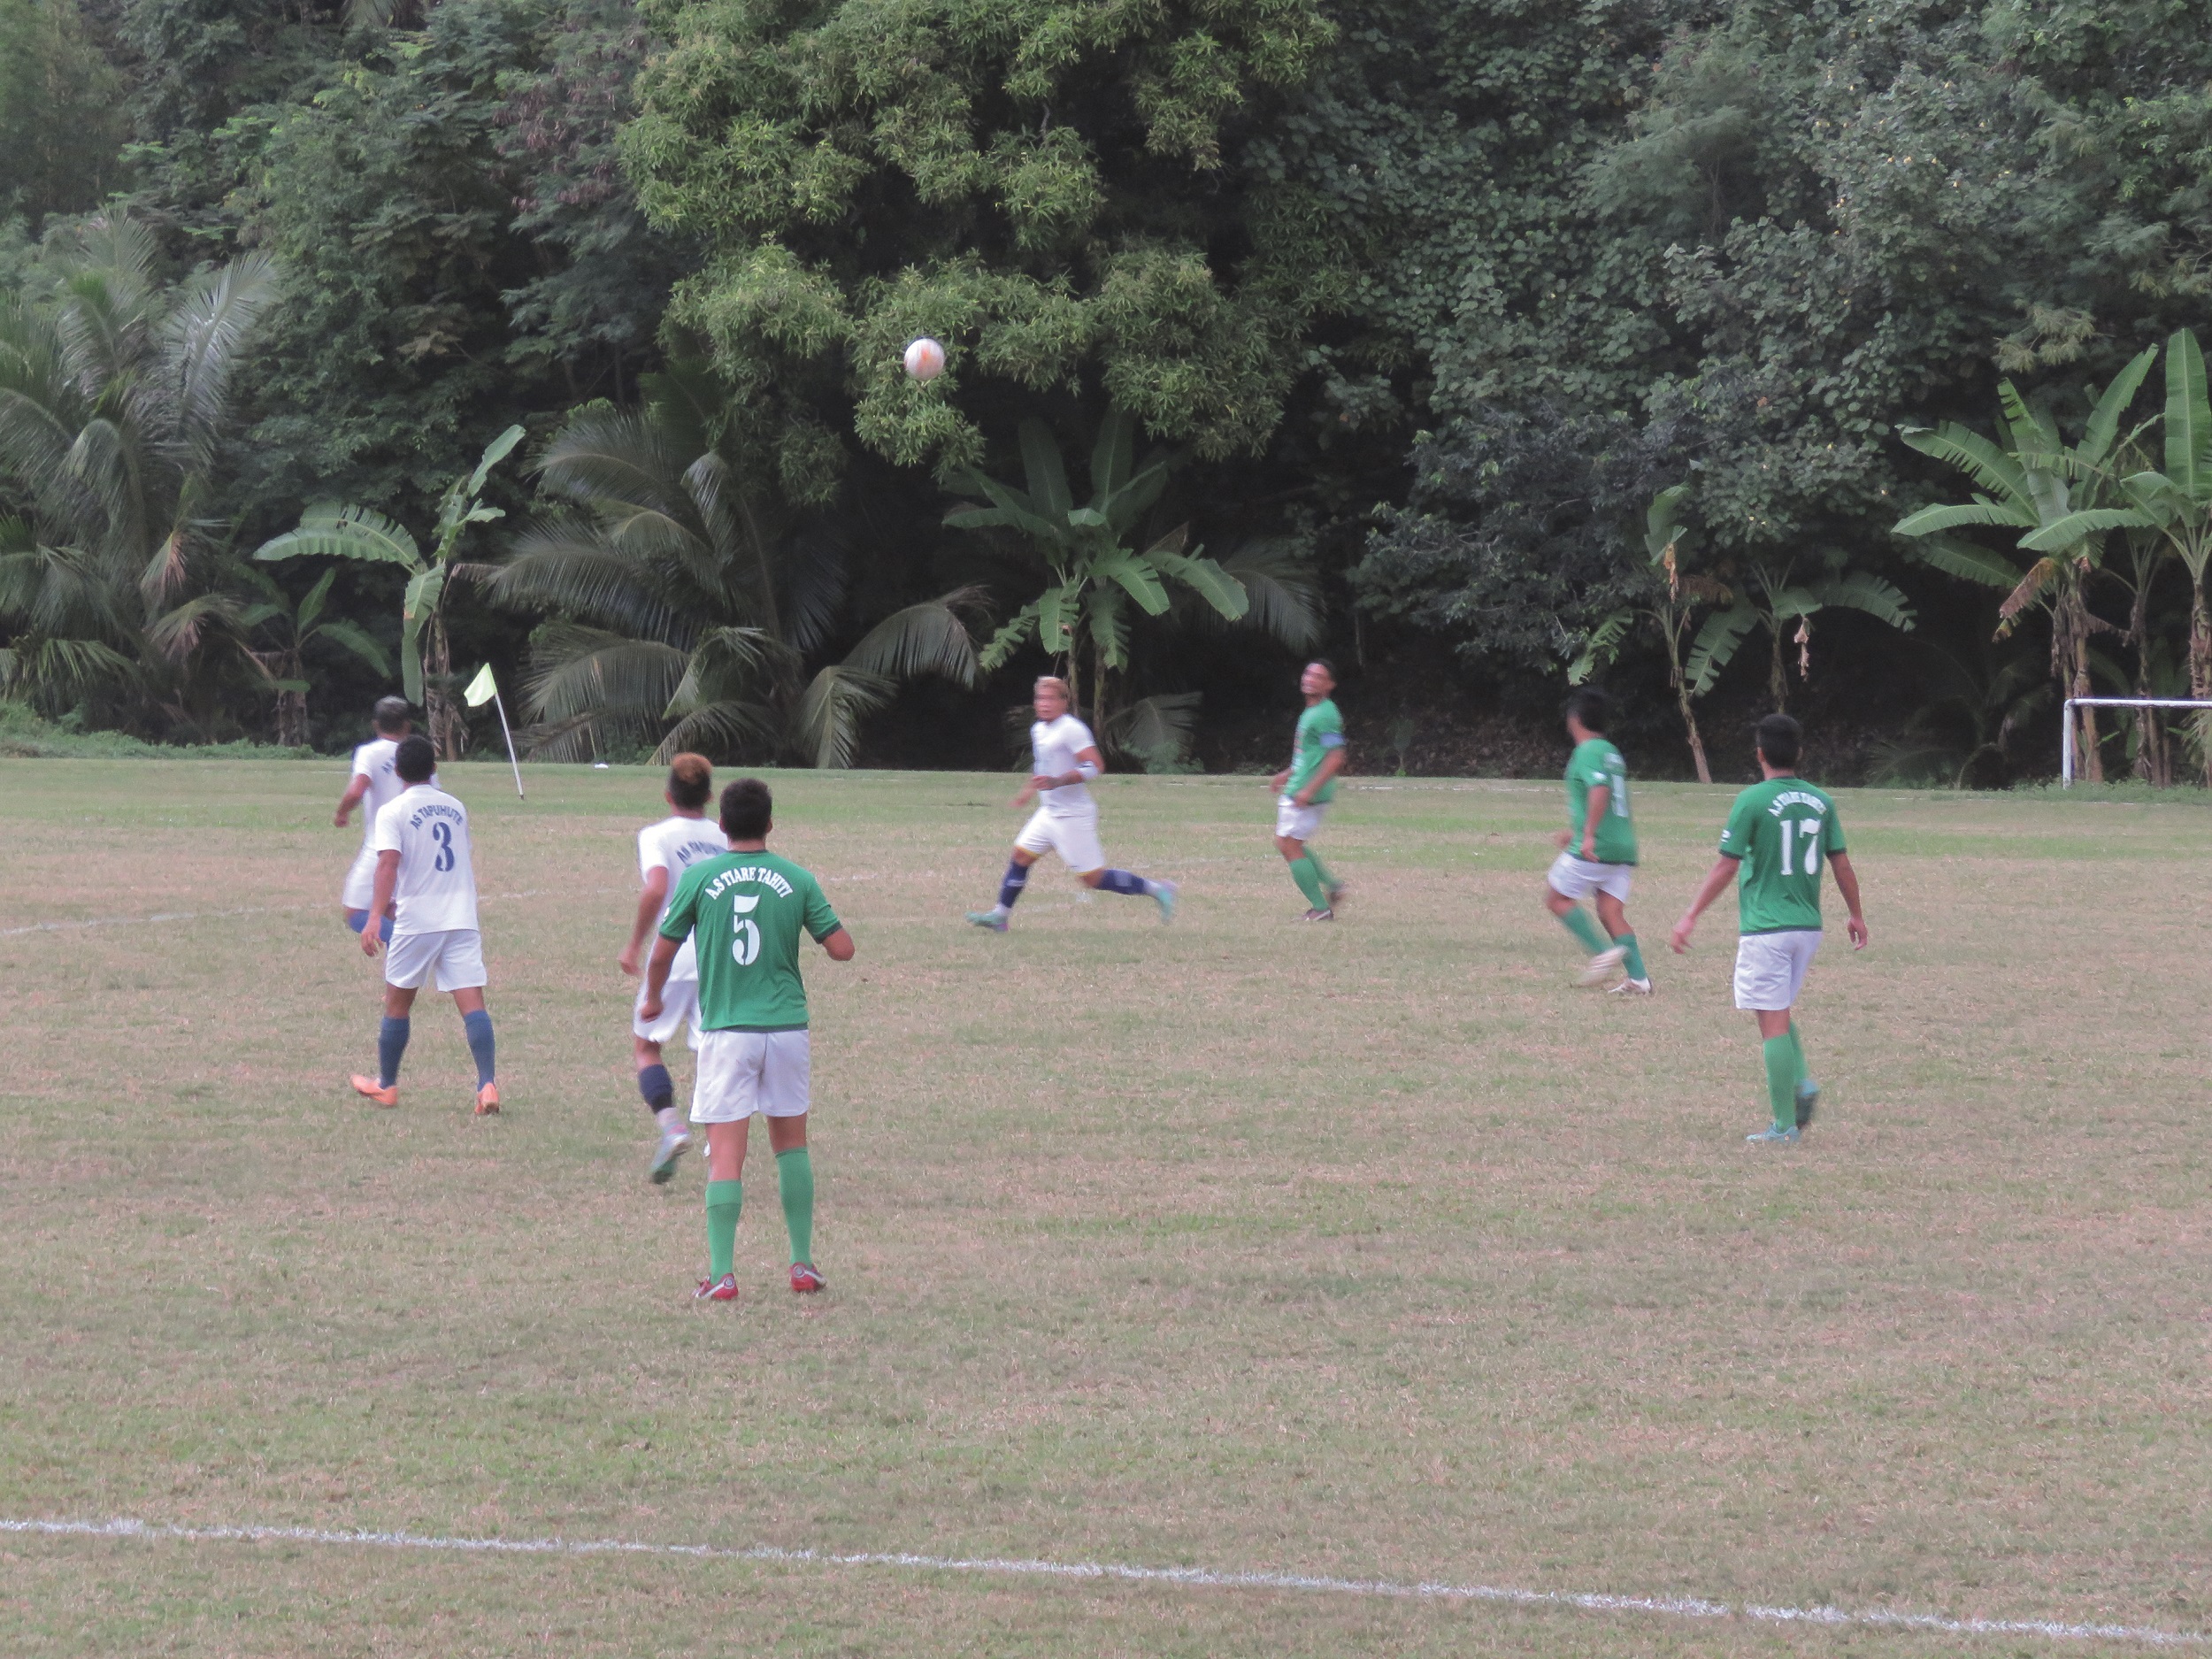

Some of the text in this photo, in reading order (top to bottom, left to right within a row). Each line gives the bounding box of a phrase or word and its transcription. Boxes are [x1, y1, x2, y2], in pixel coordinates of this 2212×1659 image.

[410, 814, 423, 831] AS
[433, 821, 455, 872] 3
[1779, 818, 1822, 876] 17
[719, 866, 757, 887] TIARE
[757, 866, 794, 898] TAHITI
[732, 894, 761, 966] 5
